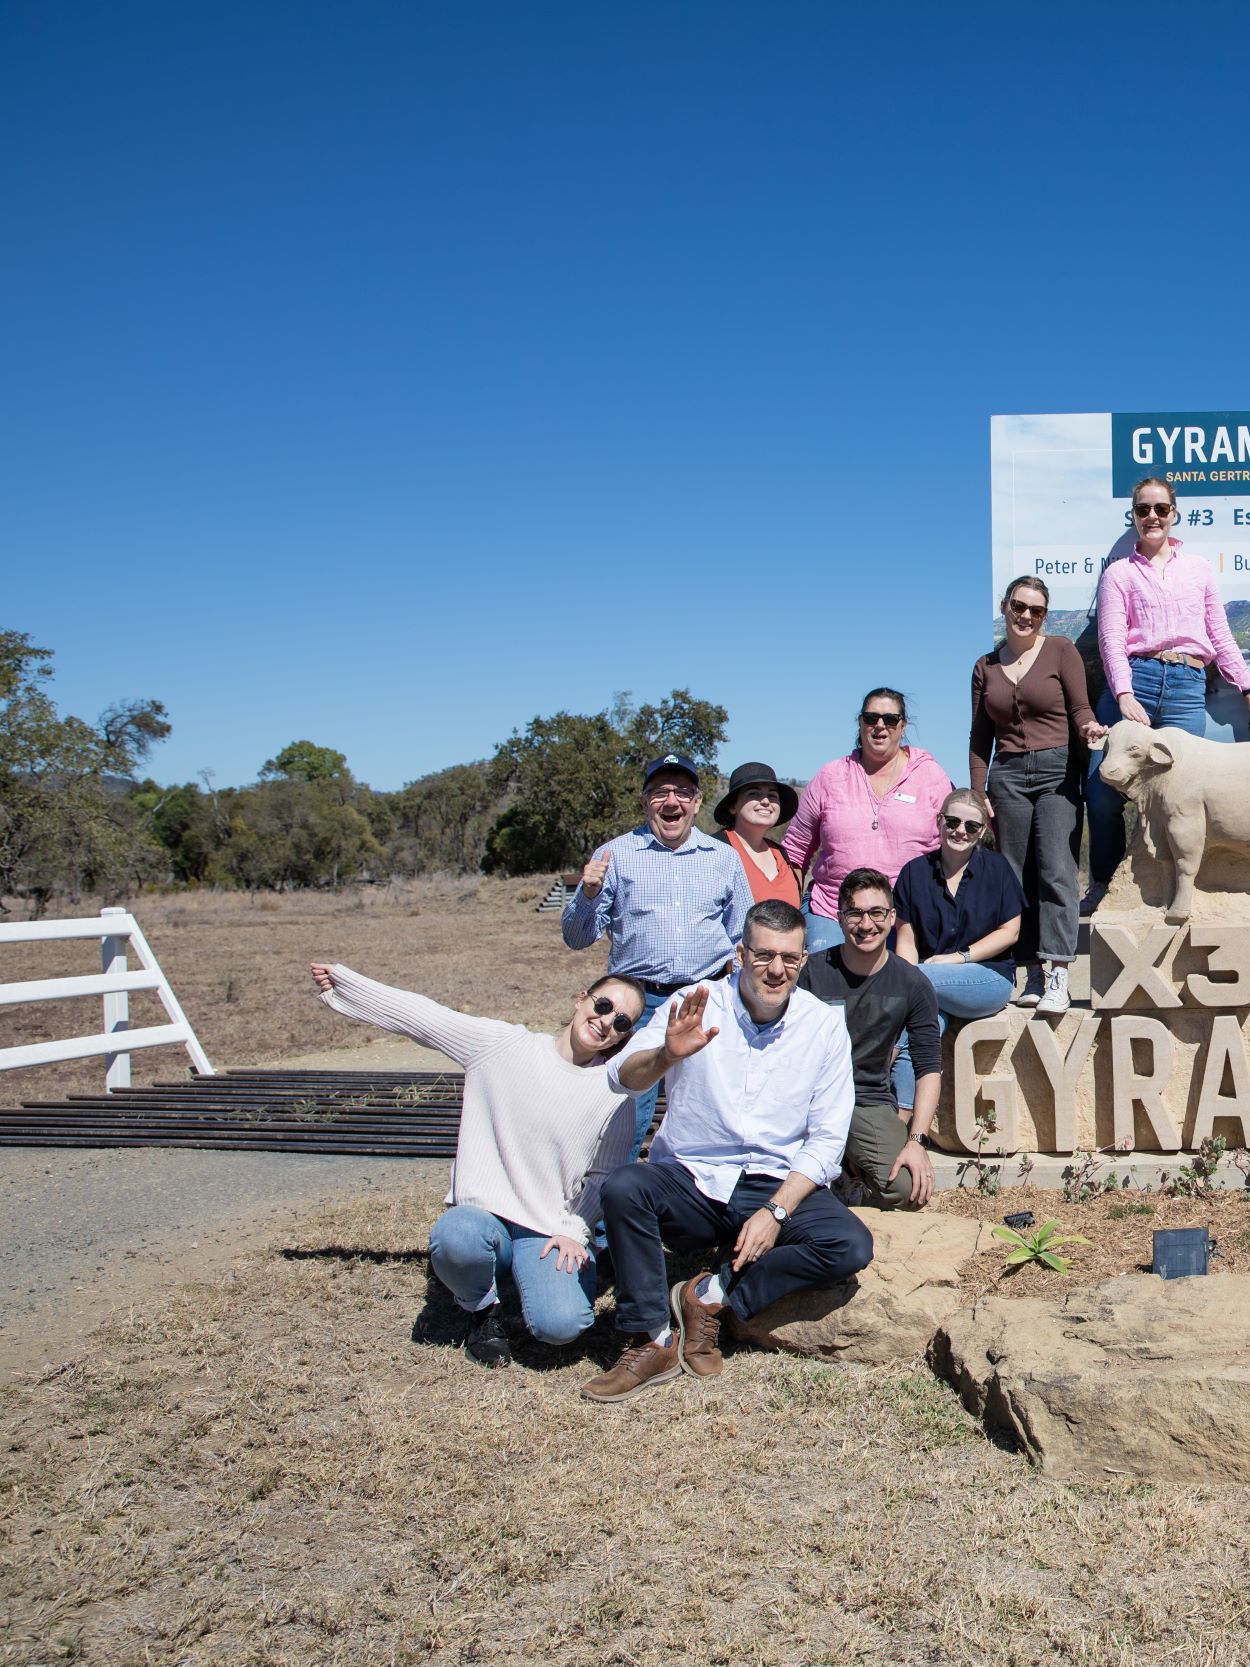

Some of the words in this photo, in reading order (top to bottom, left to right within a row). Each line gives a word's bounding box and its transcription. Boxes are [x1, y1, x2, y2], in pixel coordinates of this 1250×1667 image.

[1165, 471, 1206, 482] SANTA
[1187, 509, 1214, 526] #3
[1035, 558, 1078, 574] Peter
[1084, 557, 1094, 574] &
